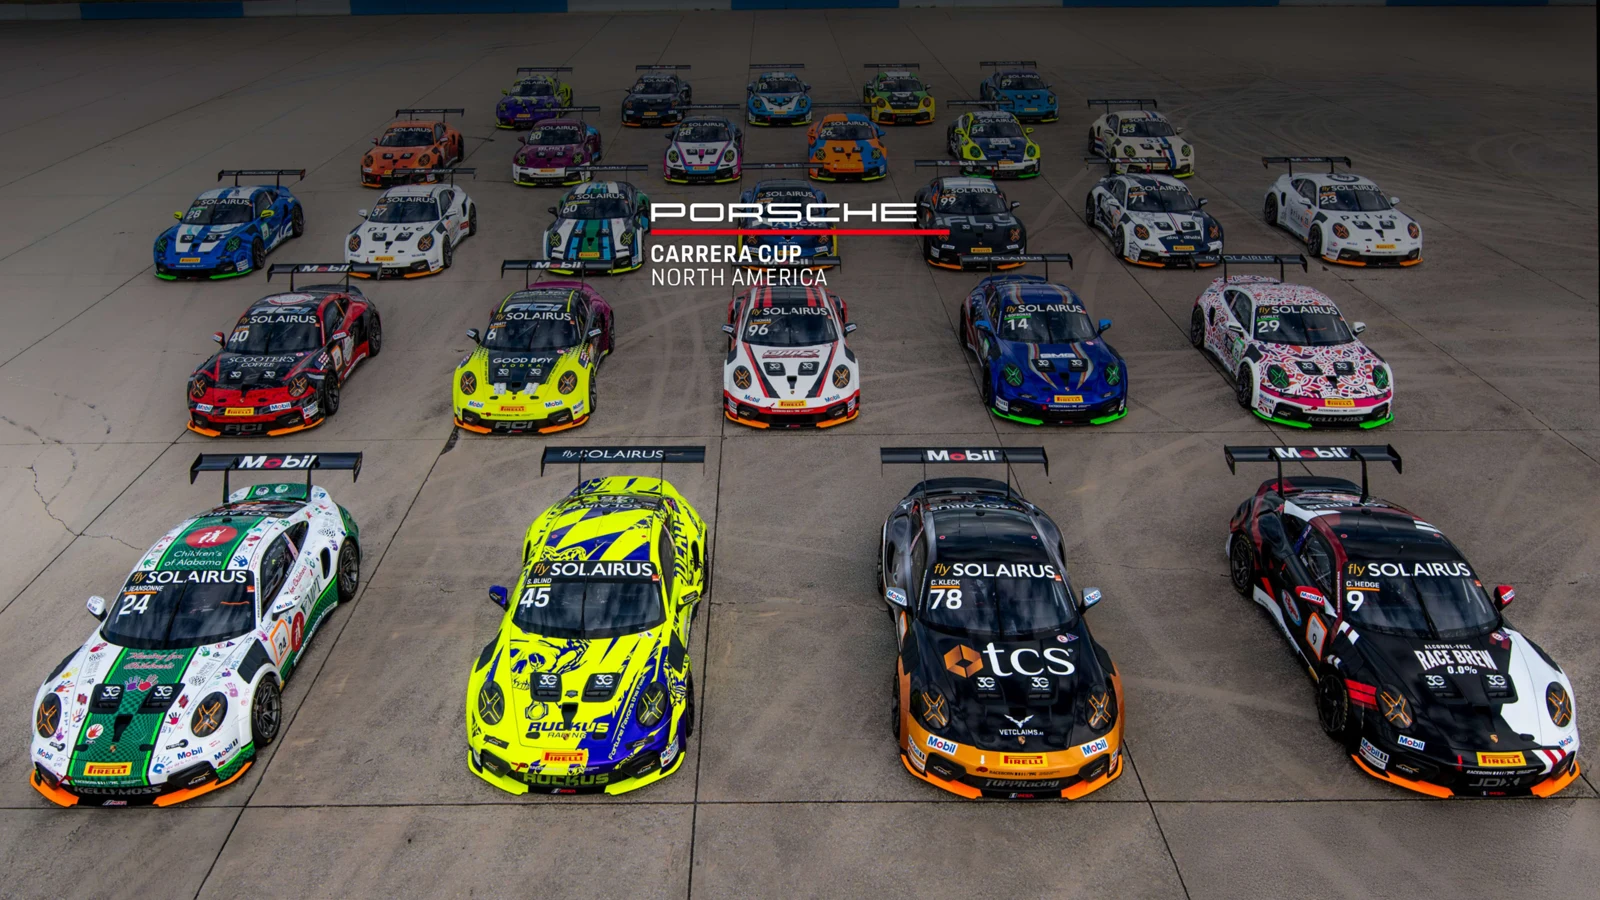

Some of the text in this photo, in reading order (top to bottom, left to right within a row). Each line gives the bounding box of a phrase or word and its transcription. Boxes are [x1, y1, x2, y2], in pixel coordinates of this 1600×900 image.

[941, 197, 956, 206] 99
[1130, 195, 1145, 204] 71
[1320, 195, 1338, 205] 23
[187, 209, 202, 220] 28
[372, 208, 387, 217] 37
[563, 204, 577, 214] 60
[302, 264, 350, 272] Mobil
[763, 307, 827, 316] SOLAIRUS
[1006, 304, 1083, 313] fly SOLAIRUS
[1258, 306, 1338, 315] fly SOLAIRUS
[250, 315, 317, 324] SOLAIRUS
[495, 312, 571, 321] fly SOLAIRUS
[748, 323, 768, 336] 96
[1007, 318, 1028, 331] 14
[1257, 320, 1280, 333] 29
[229, 330, 249, 342] 40
[487, 328, 497, 340] 6
[227, 356, 296, 364] SCOOTER'S
[545, 400, 563, 408] Mobil
[744, 394, 760, 403] Mobil
[825, 394, 840, 403] Mobil
[271, 403, 291, 411] Mobil
[562, 449, 665, 459] fly SOLAIRUS
[927, 450, 997, 461] Mobil
[1275, 447, 1347, 458] Mobil
[238, 454, 317, 469] Mobil
[165, 558, 222, 567] of Alabama
[533, 562, 653, 577] fly SOLAIRUS
[933, 563, 1056, 578] fly SOLAIRUS
[1347, 562, 1471, 577] fly SOLAIRUS
[132, 570, 247, 584] fly SOLAIRUS
[519, 587, 552, 608] 45
[887, 590, 904, 603] Mobil
[930, 589, 962, 610] 78
[1085, 590, 1101, 602] Mobil
[1346, 590, 1364, 611] 9
[119, 594, 152, 615] 24
[276, 600, 293, 610] Mobil
[982, 642, 1075, 676] tcs
[1414, 650, 1498, 671] RACE BREW
[1447, 665, 1477, 675] 0.0%
[539, 674, 557, 685] 30
[595, 674, 614, 685] 30
[977, 677, 996, 687] 30
[1031, 677, 1049, 687] 30
[1425, 675, 1444, 686] 30
[1486, 674, 1505, 686] 30
[103, 686, 121, 697] 30
[154, 686, 173, 697] 30
[527, 721, 609, 733] RUCKUS
[607, 728, 624, 760] Fortune
[621, 702, 635, 729] Favors
[631, 688, 641, 703] the
[928, 736, 956, 753] Mobil
[1082, 739, 1108, 756] Mobil
[1400, 736, 1424, 749] Mobil
[1558, 736, 1574, 748] Mobil
[36, 747, 53, 760] Mobil
[177, 746, 203, 760] Mobil
[213, 742, 234, 760] Mobil
[1361, 739, 1381, 757] Mobil
[544, 752, 583, 761] PIRELLI
[1004, 755, 1043, 764] PIRELLI
[1481, 755, 1521, 764] PIRELLI
[88, 765, 128, 774] PIRELLI
[523, 773, 609, 786] RUCKUS
[74, 785, 162, 796] KELLYMOSS
